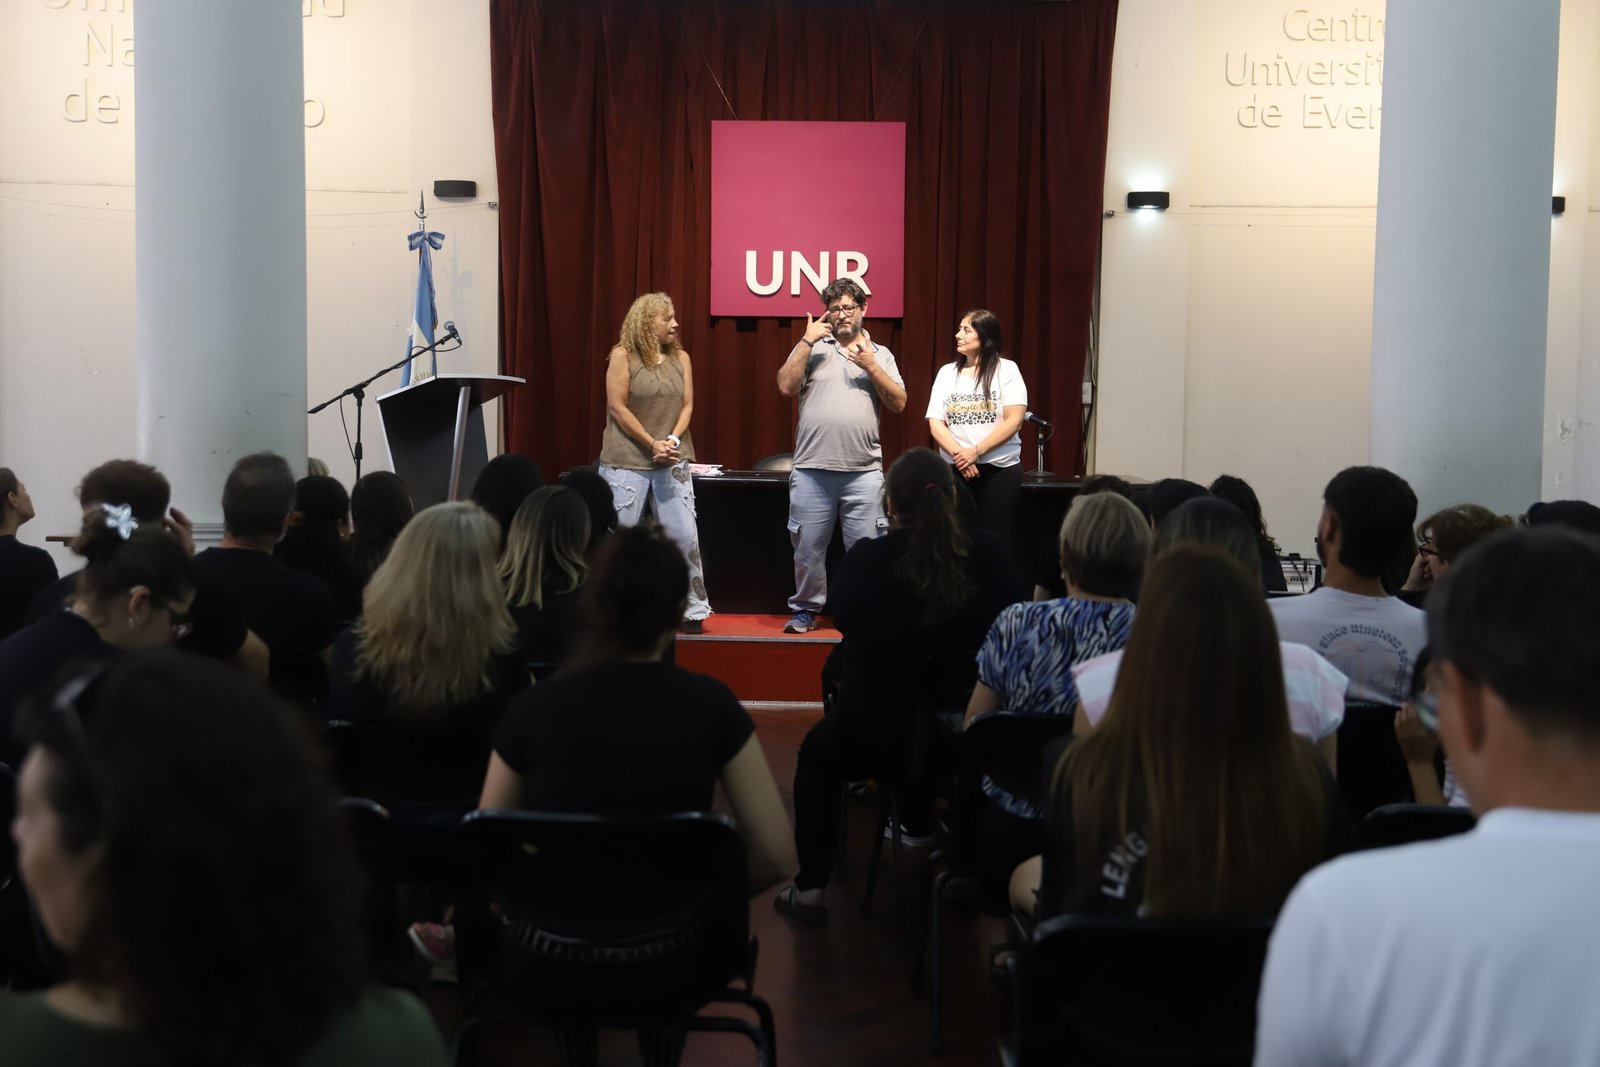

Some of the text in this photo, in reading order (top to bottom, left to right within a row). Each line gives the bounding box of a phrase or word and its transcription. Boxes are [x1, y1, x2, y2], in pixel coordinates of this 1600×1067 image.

[1282, 6, 1385, 42] Centr
[62, 77, 121, 125] de
[1236, 94, 1282, 129] de
[745, 249, 873, 297] UNR
[1319, 625, 1348, 649] since
[1350, 623, 1402, 649] nineteen
